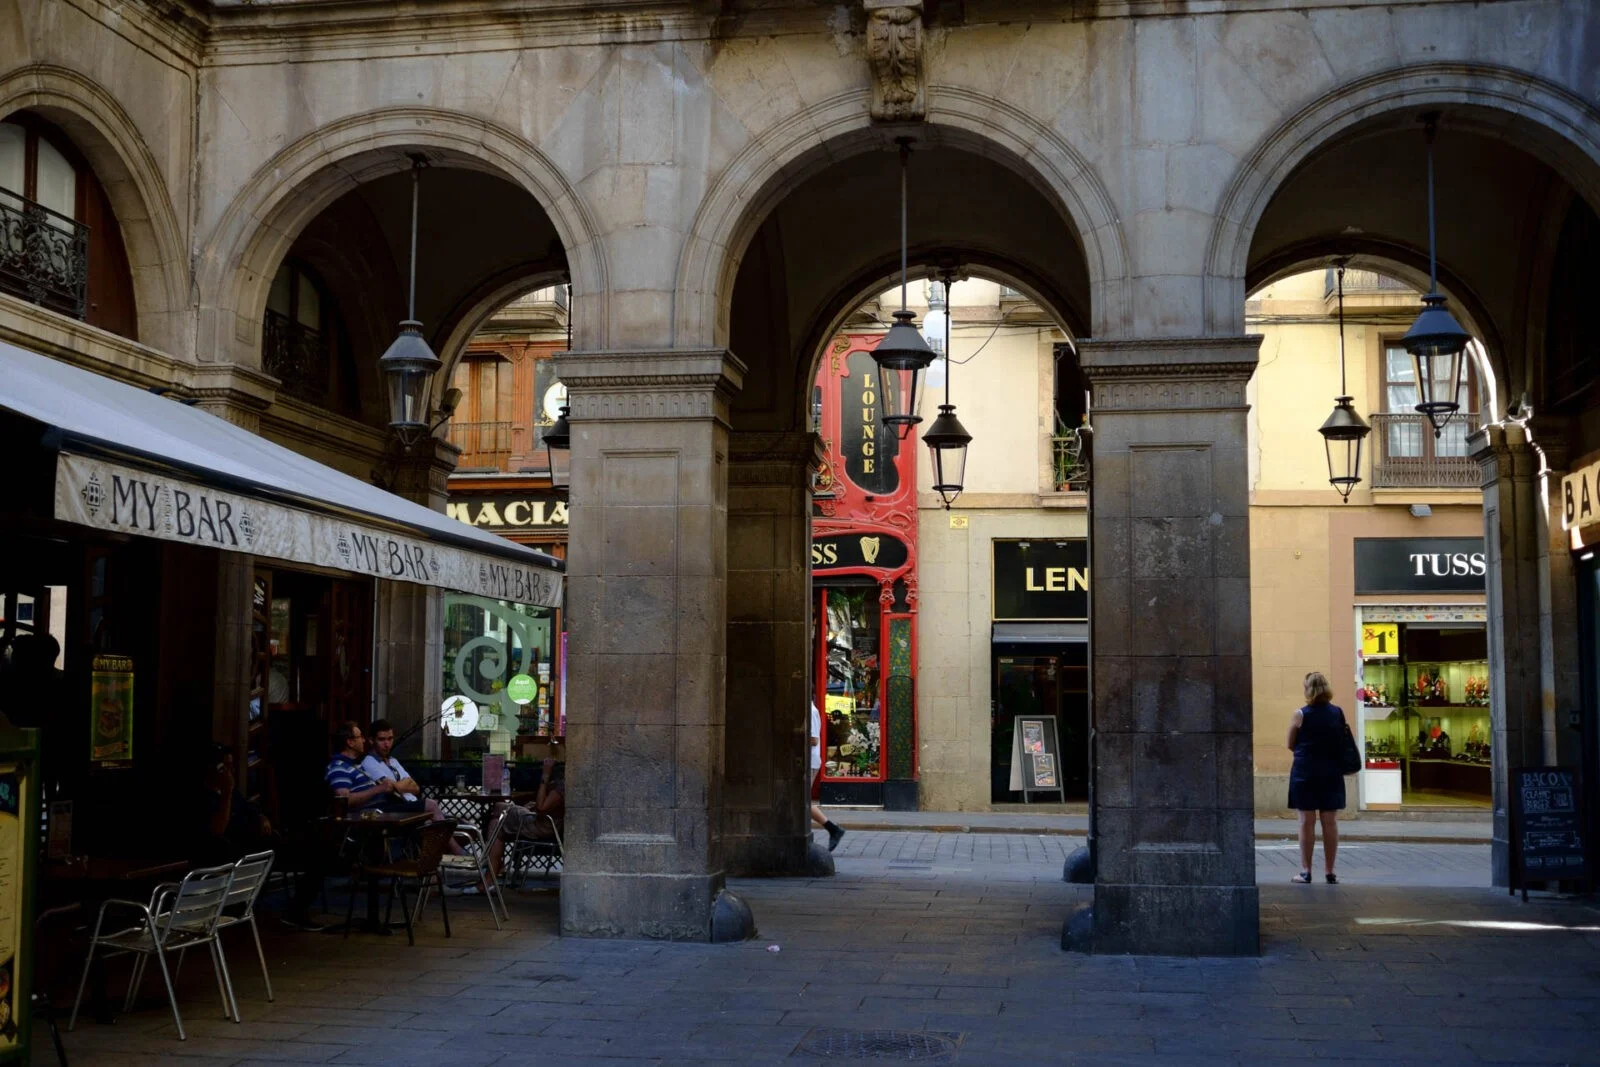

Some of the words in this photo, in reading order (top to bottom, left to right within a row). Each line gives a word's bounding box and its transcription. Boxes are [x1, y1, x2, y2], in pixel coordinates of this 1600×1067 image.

[862, 374, 875, 473] LOUNGE
[111, 475, 160, 530] MY
[174, 490, 238, 545] BAR
[446, 500, 569, 526] MACIA
[352, 533, 380, 572] MY
[388, 540, 430, 581] BAR
[1409, 553, 1486, 576] TUSS
[489, 564, 510, 597] MY
[515, 569, 541, 602] BAR
[1026, 567, 1089, 591] LEN
[99, 658, 110, 670] MY
[111, 659, 128, 671] BAR
